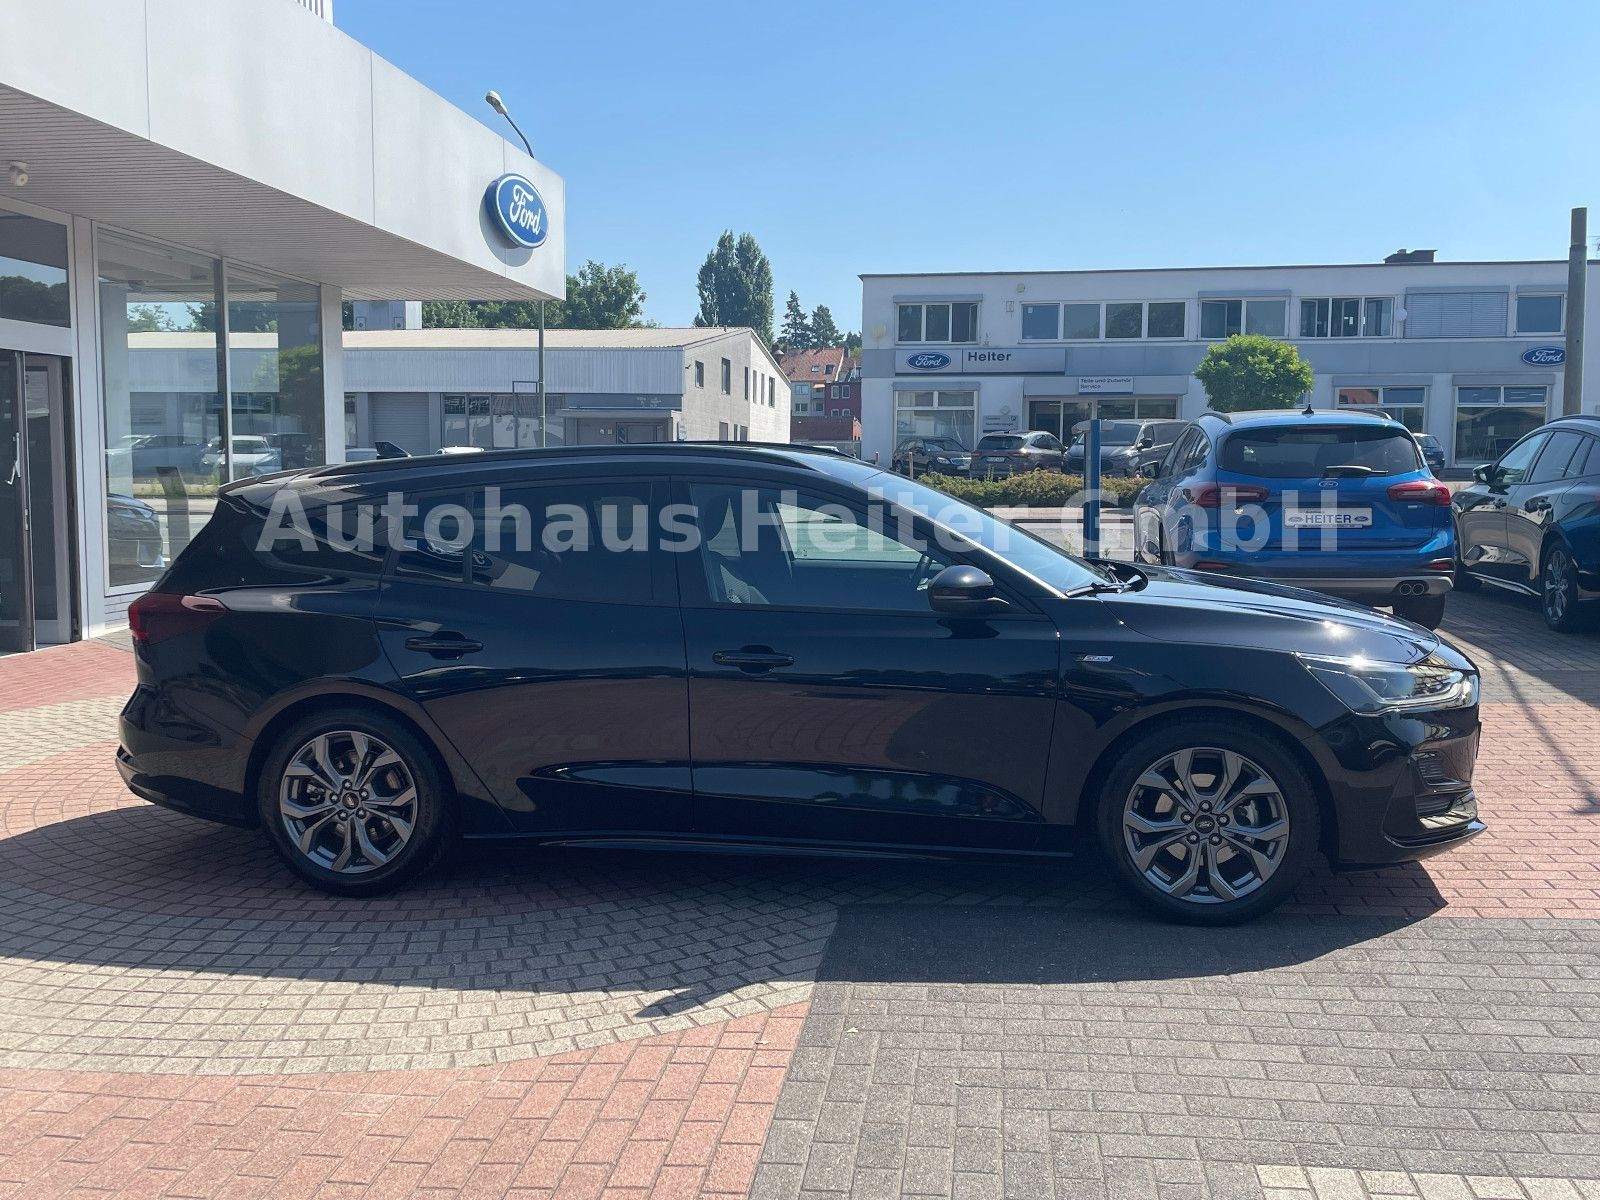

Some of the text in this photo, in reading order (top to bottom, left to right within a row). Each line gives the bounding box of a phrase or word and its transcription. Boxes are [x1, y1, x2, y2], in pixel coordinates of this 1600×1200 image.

[509, 184, 541, 235] Ford
[915, 354, 941, 366] Ford
[1532, 350, 1563, 361] Ford
[1305, 514, 1352, 524] HEITER
